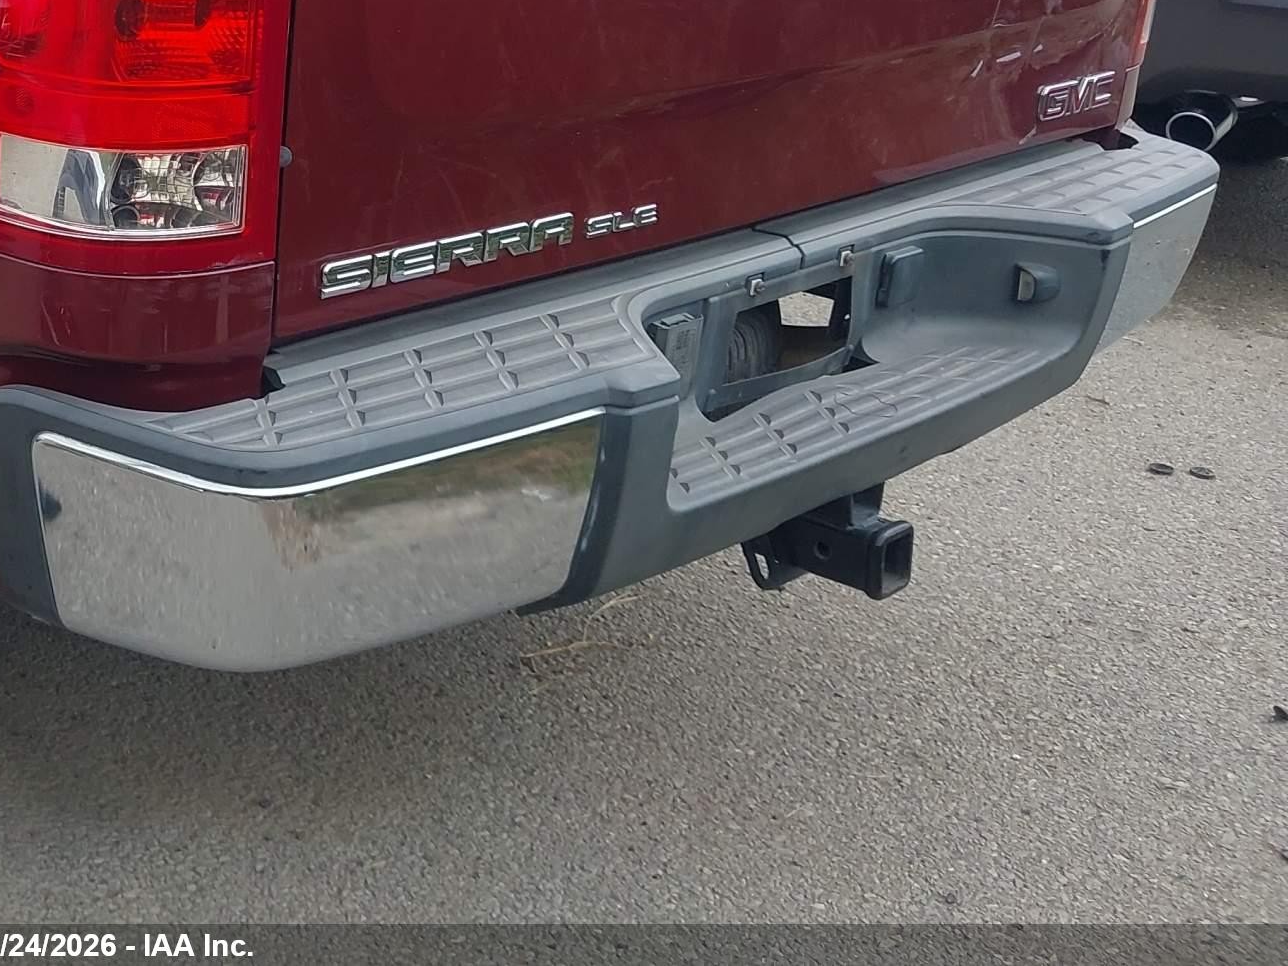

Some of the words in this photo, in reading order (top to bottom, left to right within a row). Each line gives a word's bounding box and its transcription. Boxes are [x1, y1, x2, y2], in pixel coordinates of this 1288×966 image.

[1037, 71, 1115, 121] GMC
[320, 212, 574, 300] SIERRA
[584, 203, 657, 239] SLE
